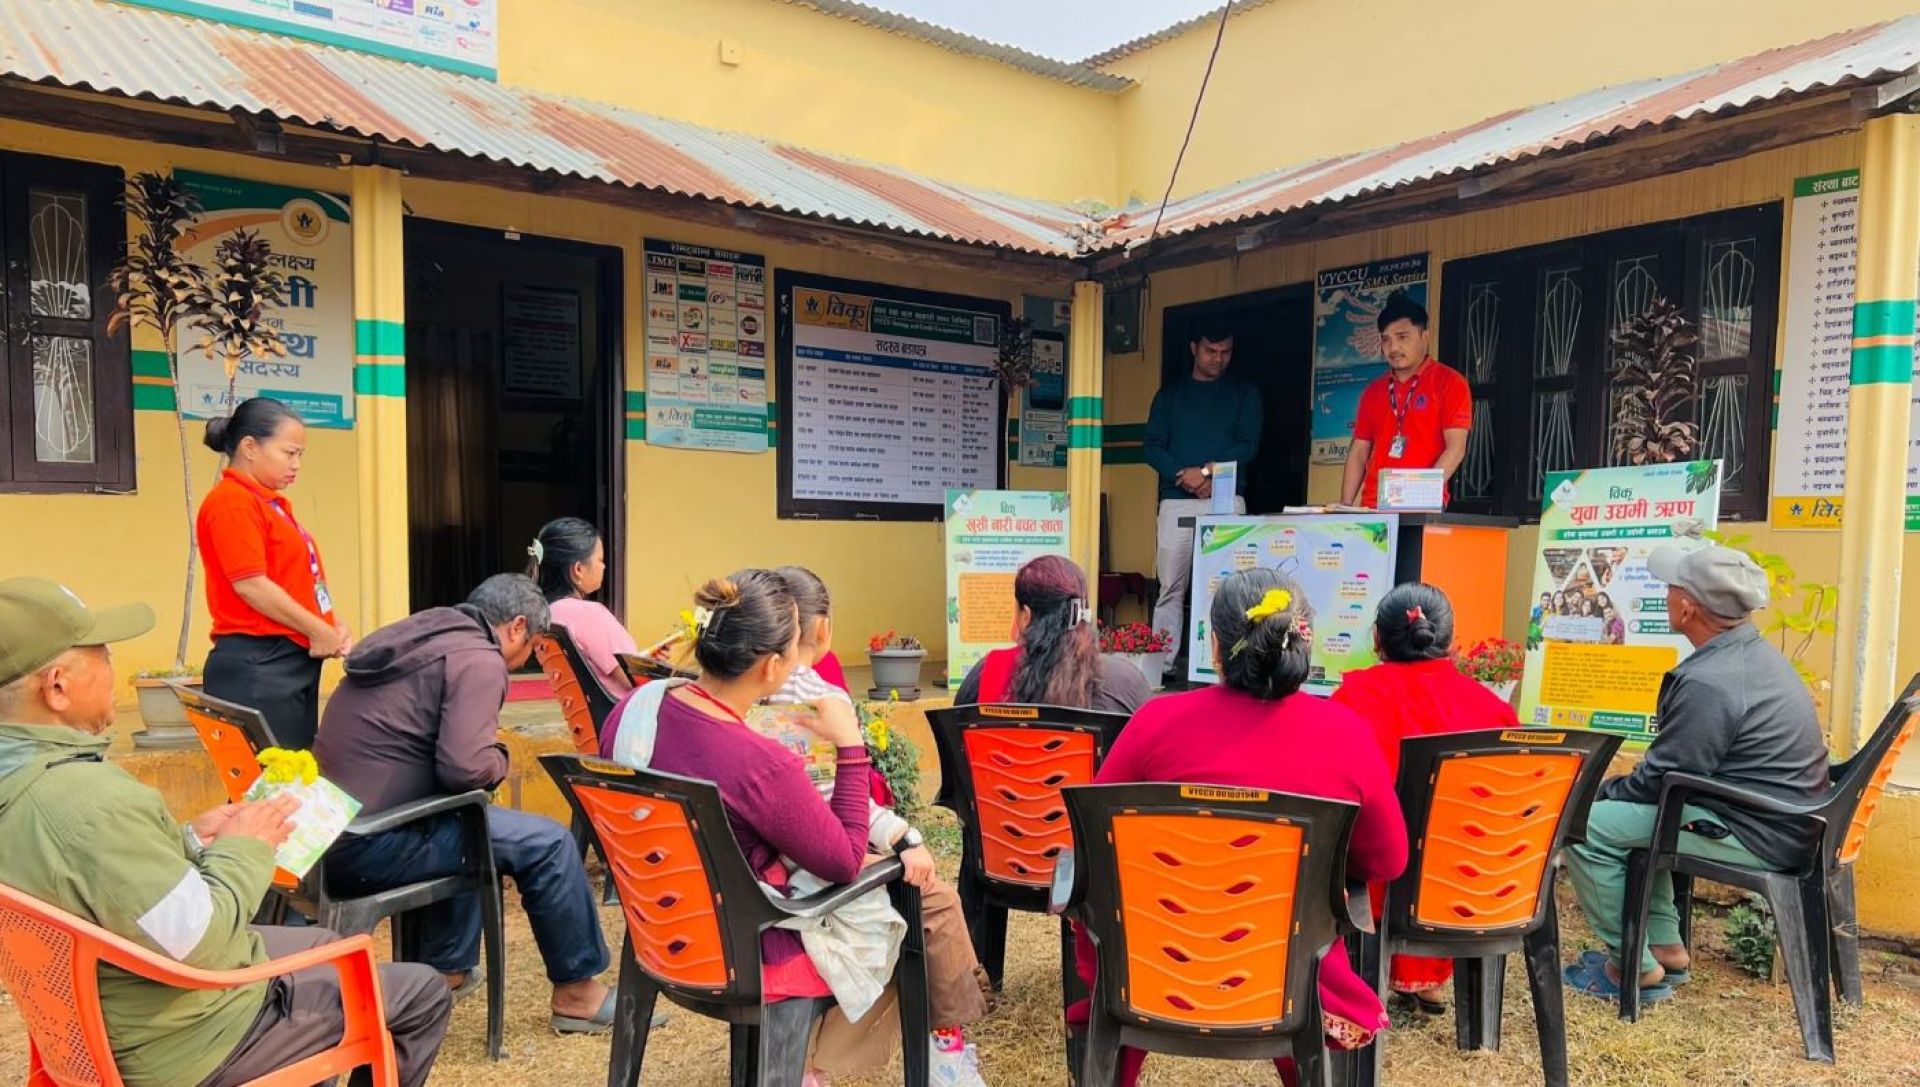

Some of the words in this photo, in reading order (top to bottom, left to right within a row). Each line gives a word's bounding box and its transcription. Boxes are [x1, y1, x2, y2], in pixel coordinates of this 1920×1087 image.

[1319, 267, 1370, 287] VYCCU
[239, 359, 302, 378] सदस्य
[1571, 506, 1599, 523] युवा
[1605, 500, 1648, 519] उद्यमी
[1655, 501, 1695, 517] ऋण
[1040, 519, 1064, 533] खाता
